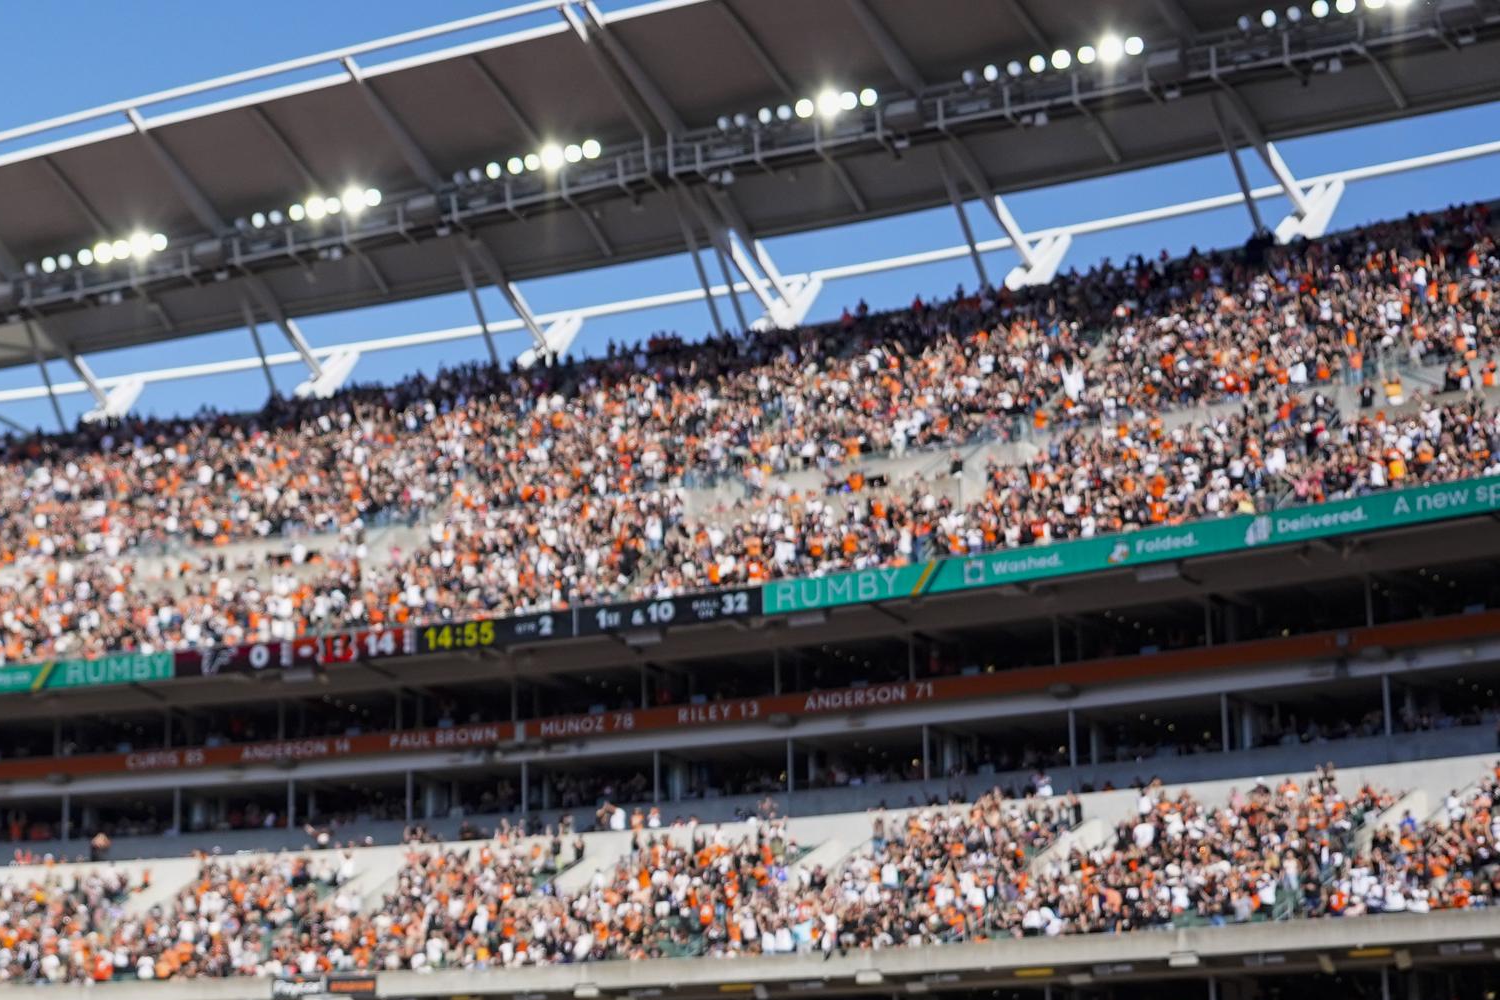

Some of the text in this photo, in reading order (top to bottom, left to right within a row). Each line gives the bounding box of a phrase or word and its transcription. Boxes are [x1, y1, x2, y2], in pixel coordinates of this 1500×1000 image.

[1393, 495, 1410, 515] A
[1416, 490, 1468, 512] new
[1277, 506, 1368, 535] Delivered.
[1135, 531, 1199, 555] Folded.
[991, 554, 1063, 576] Washed.
[776, 571, 900, 610] RUMBY
[721, 592, 749, 615] 32
[424, 620, 495, 650] 14:55
[538, 615, 554, 636] 2
[365, 633, 396, 656] 14
[66, 651, 167, 685] RUMBY
[804, 682, 933, 712] ANDERSON 71
[613, 713, 634, 730] 78
[677, 701, 759, 723] RILEY 13
[389, 727, 498, 747] PAUL BROWN
